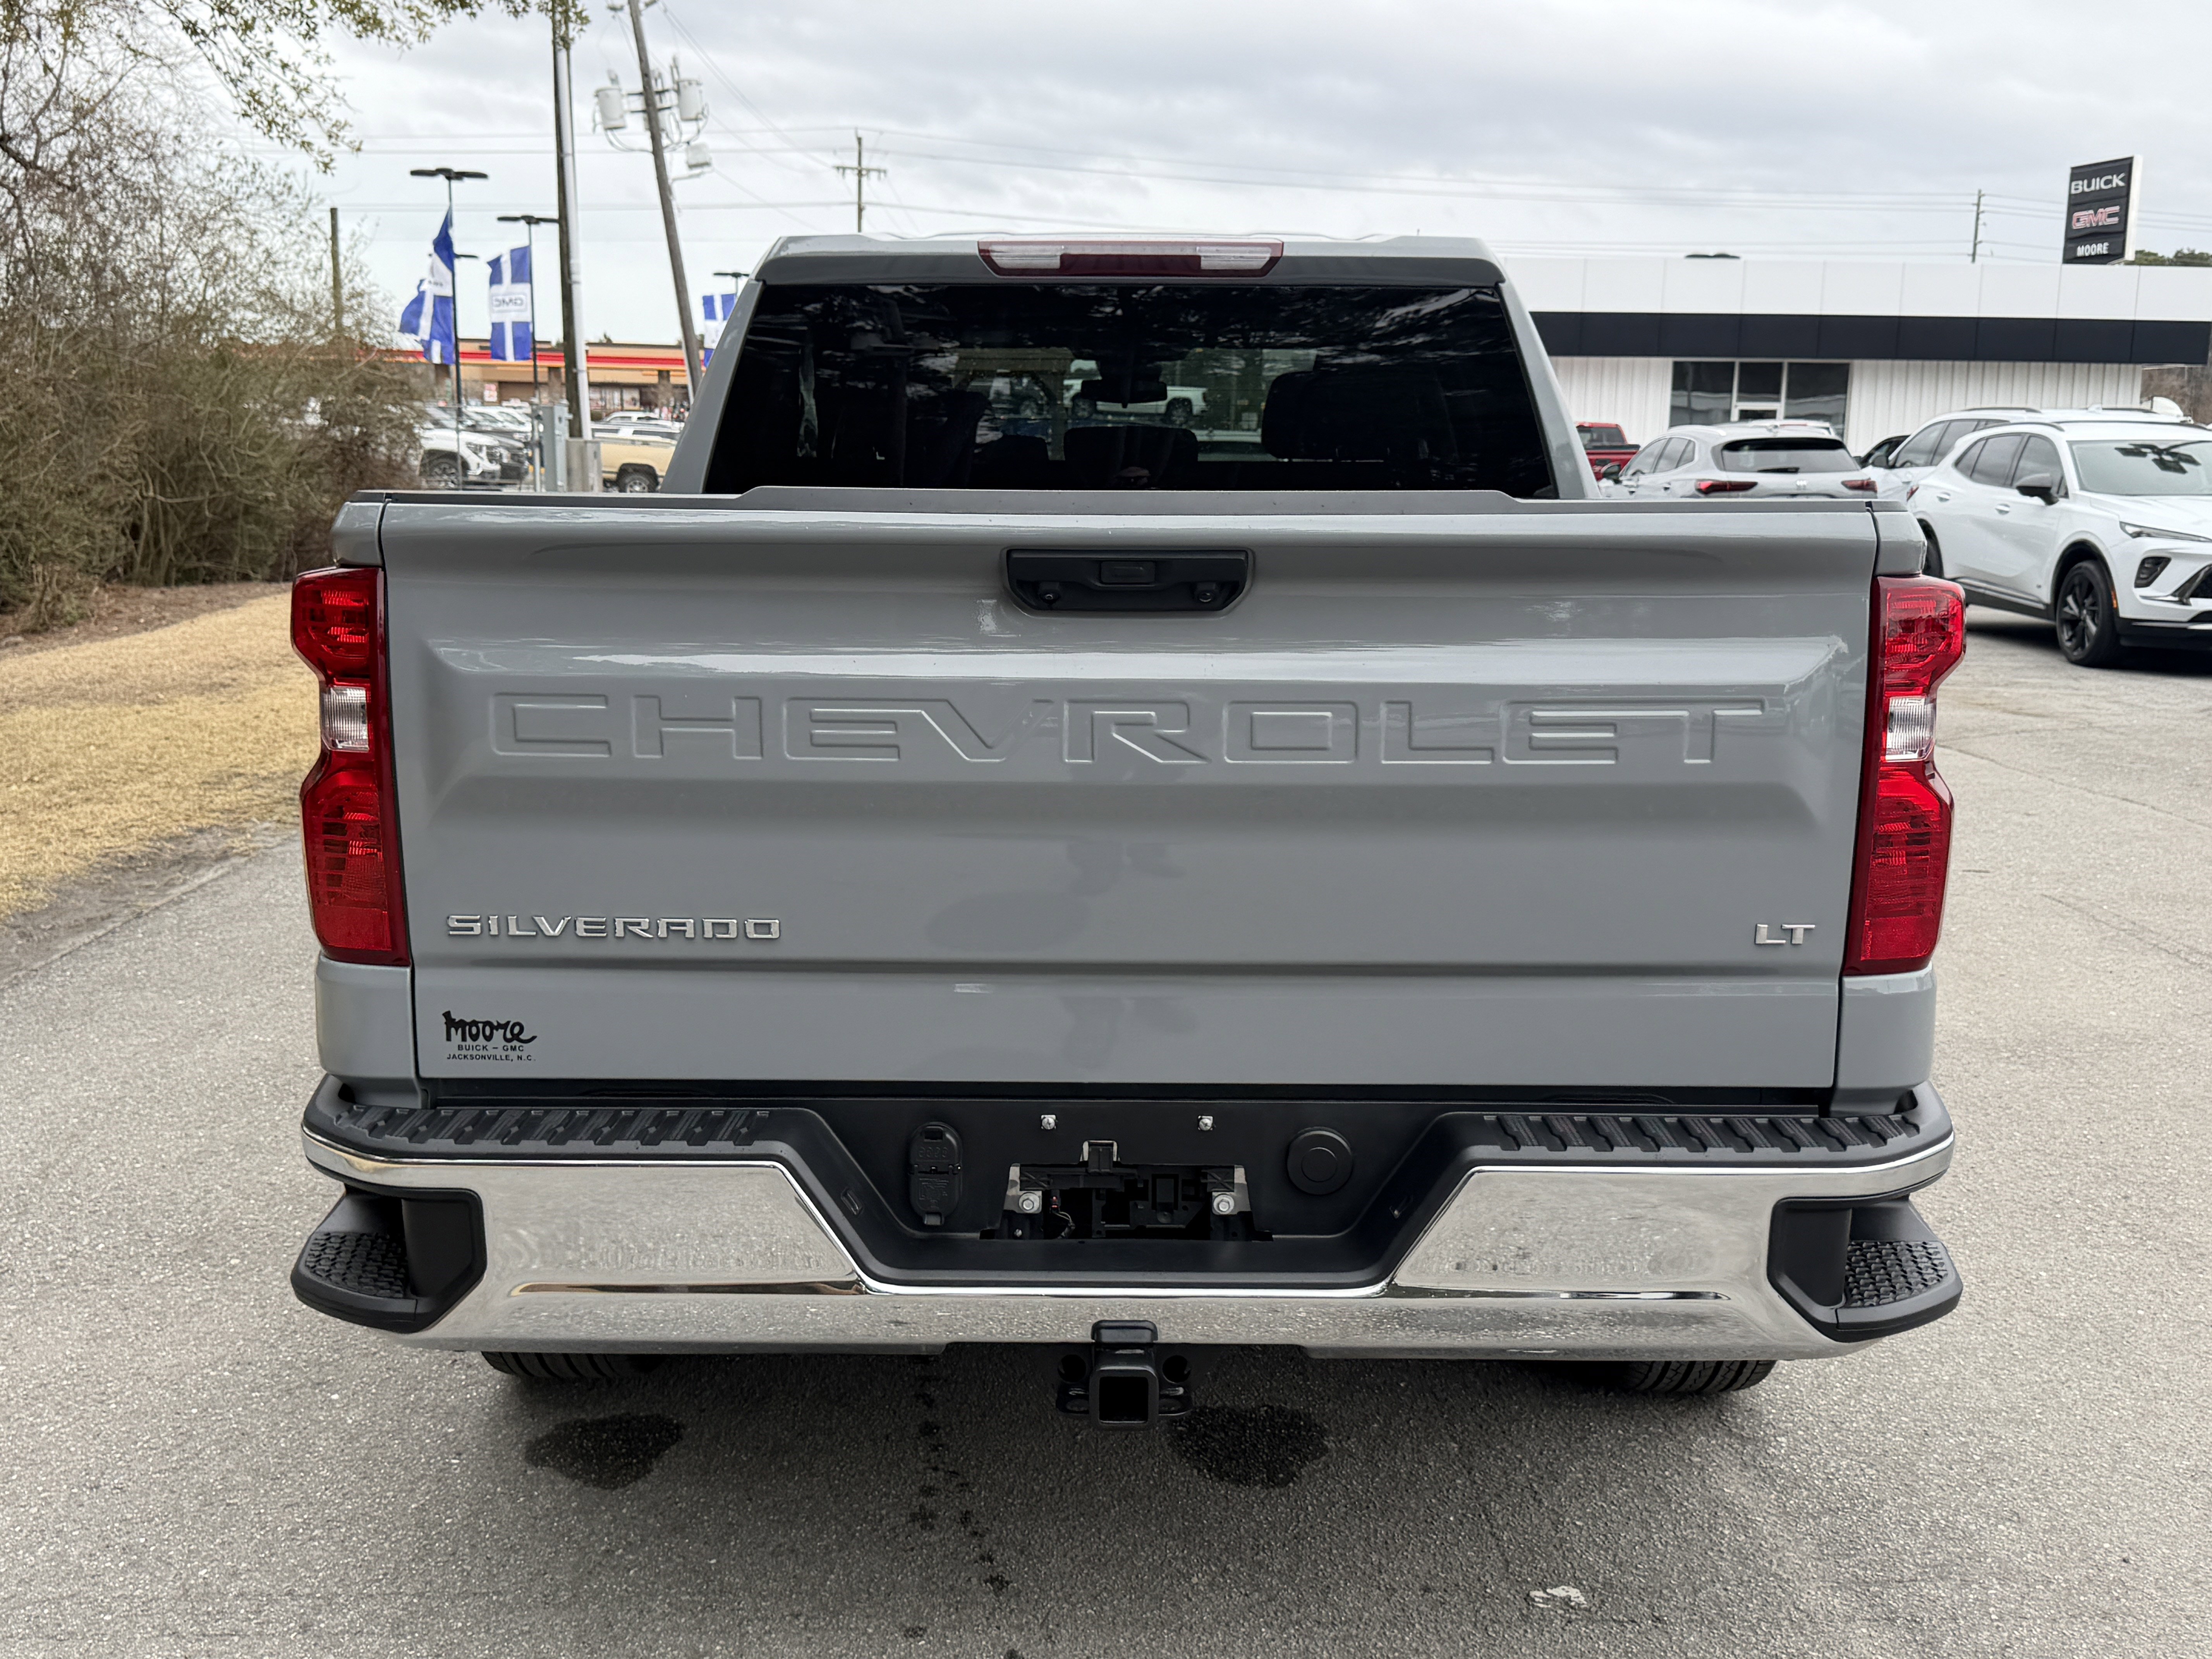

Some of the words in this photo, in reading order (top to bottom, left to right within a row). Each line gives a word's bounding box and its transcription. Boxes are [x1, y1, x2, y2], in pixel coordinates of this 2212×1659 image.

[2071, 173, 2125, 194] BUICK
[2072, 205, 2120, 229] GMC
[2077, 242, 2109, 257] MOORE
[490, 692, 1767, 765] CHEVROLET
[447, 914, 781, 939] SILVERADO
[1754, 923, 1815, 945] LT
[447, 1053, 513, 1062] JACKSONVILLE,
